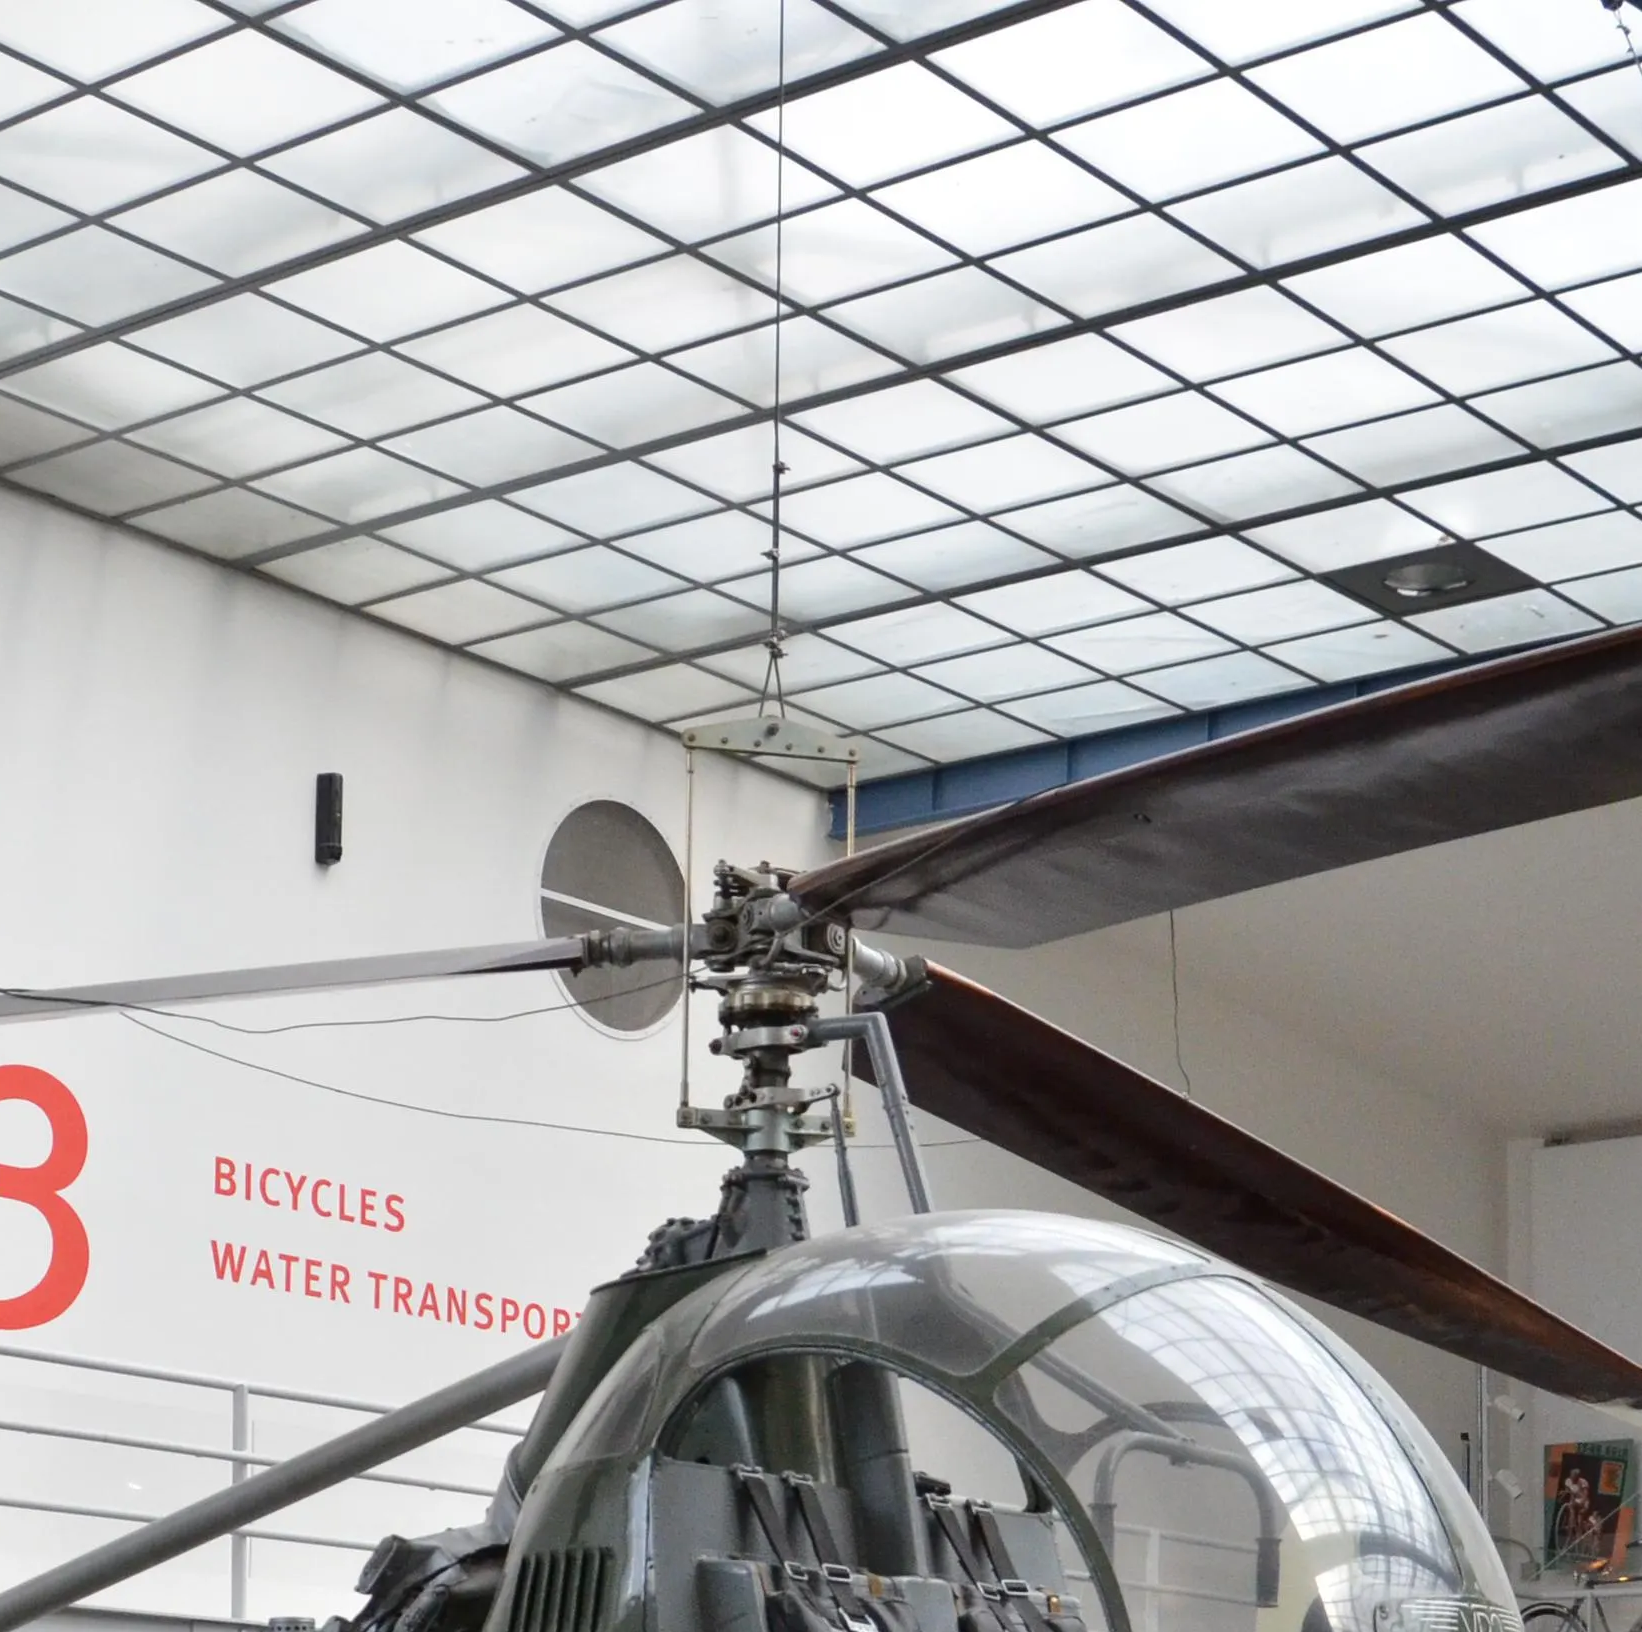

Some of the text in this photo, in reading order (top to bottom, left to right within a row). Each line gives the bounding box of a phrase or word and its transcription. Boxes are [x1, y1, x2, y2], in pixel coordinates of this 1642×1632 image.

[214, 1156, 406, 1232] BICYCLES
[210, 1240, 582, 1340] WATER TRANSPOR
